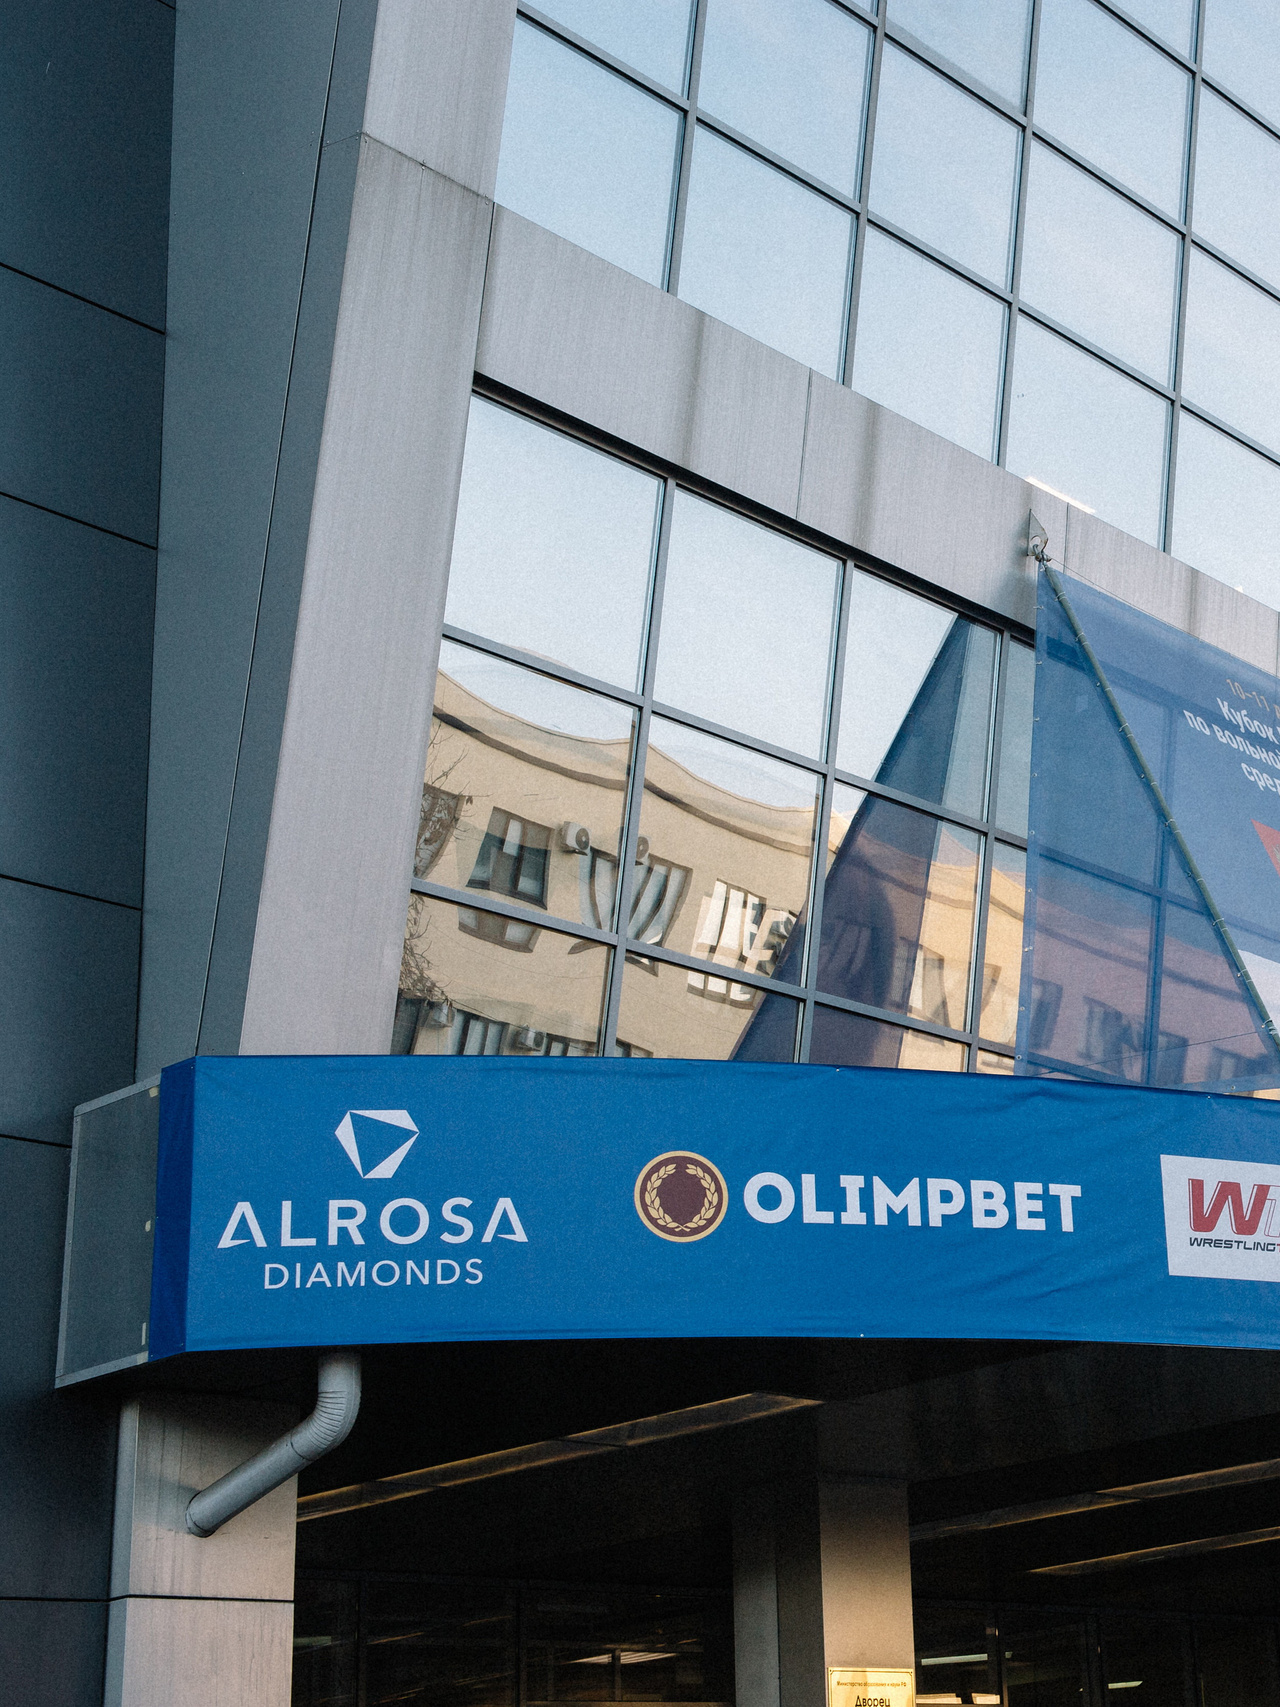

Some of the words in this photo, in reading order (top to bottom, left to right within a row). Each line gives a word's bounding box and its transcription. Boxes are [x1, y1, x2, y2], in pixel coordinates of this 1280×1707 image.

[1183, 709, 1211, 736] по
[1216, 697, 1280, 745] Кубок
[743, 1172, 1082, 1232] OLIMPBET
[217, 1197, 529, 1248] ALROSA
[263, 1258, 484, 1290] DIAMONDS
[855, 1695, 890, 1707] Дворец
